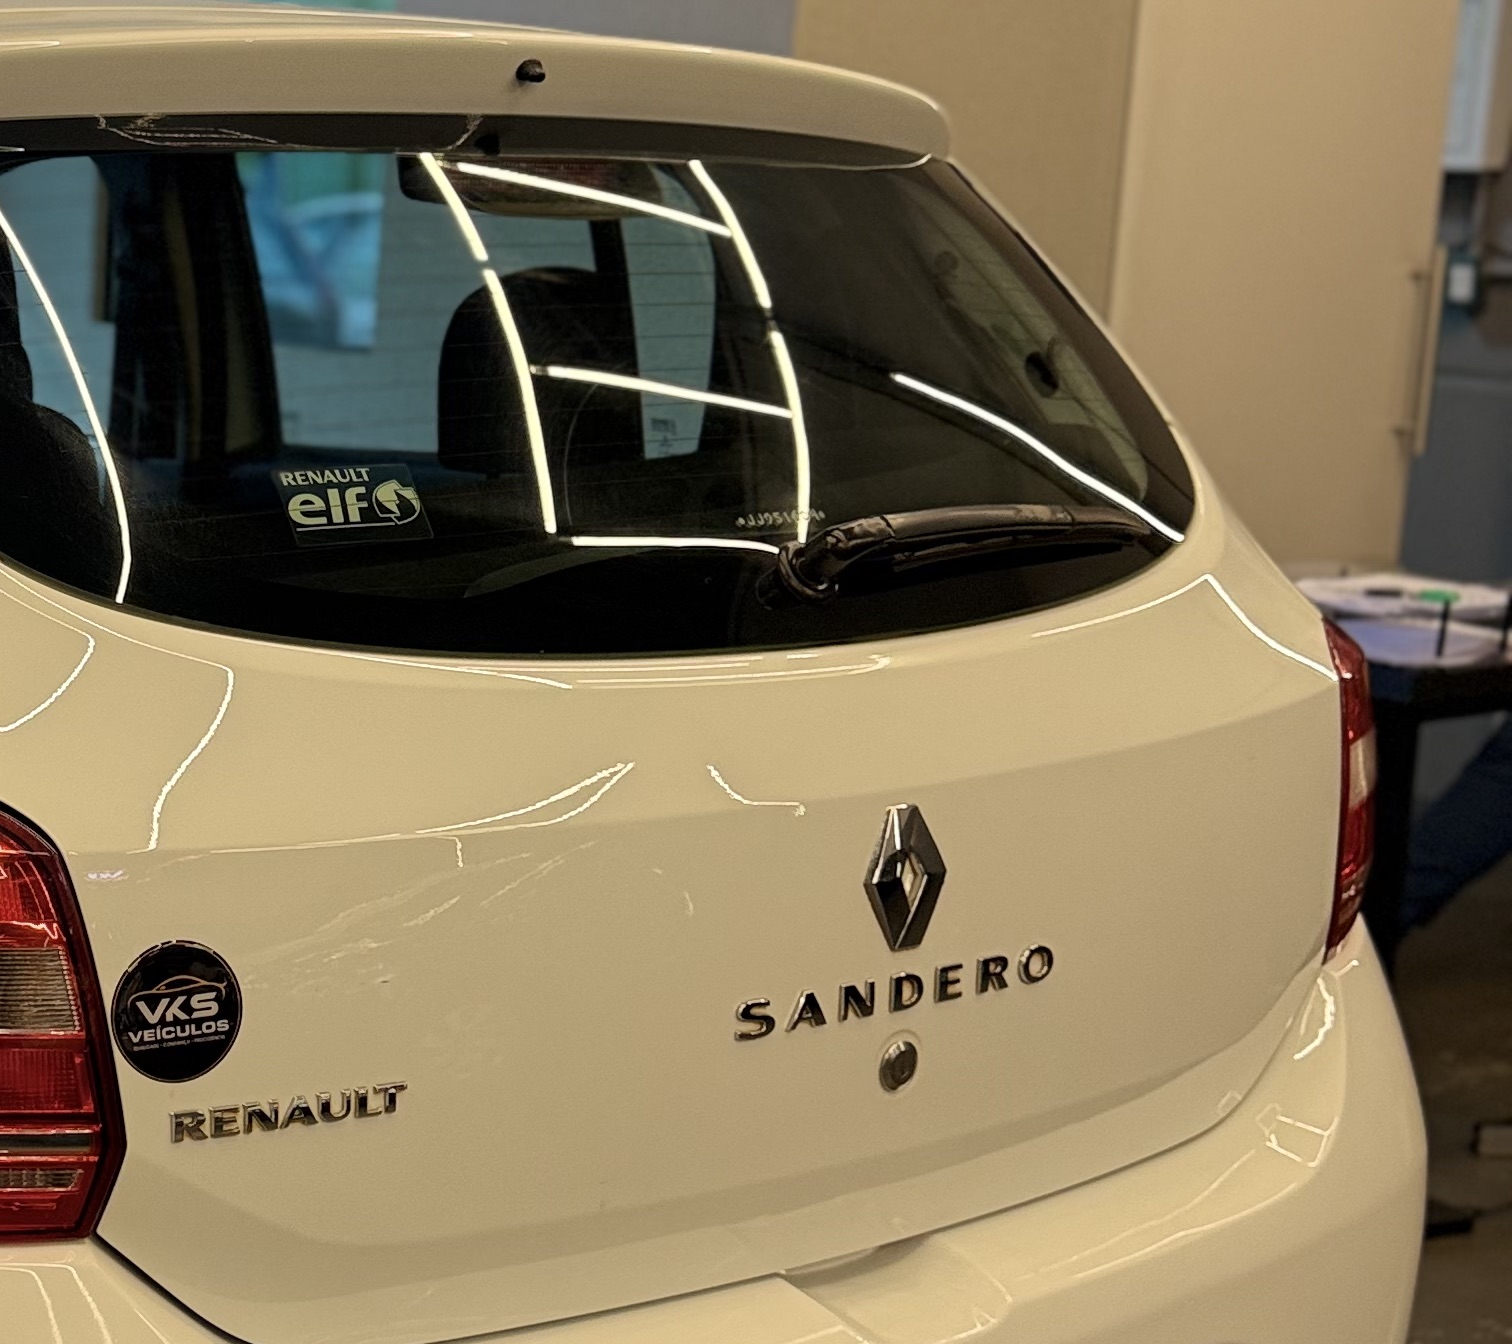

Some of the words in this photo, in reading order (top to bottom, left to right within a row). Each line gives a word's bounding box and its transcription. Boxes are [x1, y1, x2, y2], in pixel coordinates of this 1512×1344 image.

[279, 468, 370, 487] RENAULT
[287, 486, 369, 526] elf
[135, 991, 220, 1024] VKS
[734, 944, 1055, 1041] SANDERO
[127, 1017, 230, 1043] VEÍCULOS
[169, 1081, 408, 1143] RENAULT
